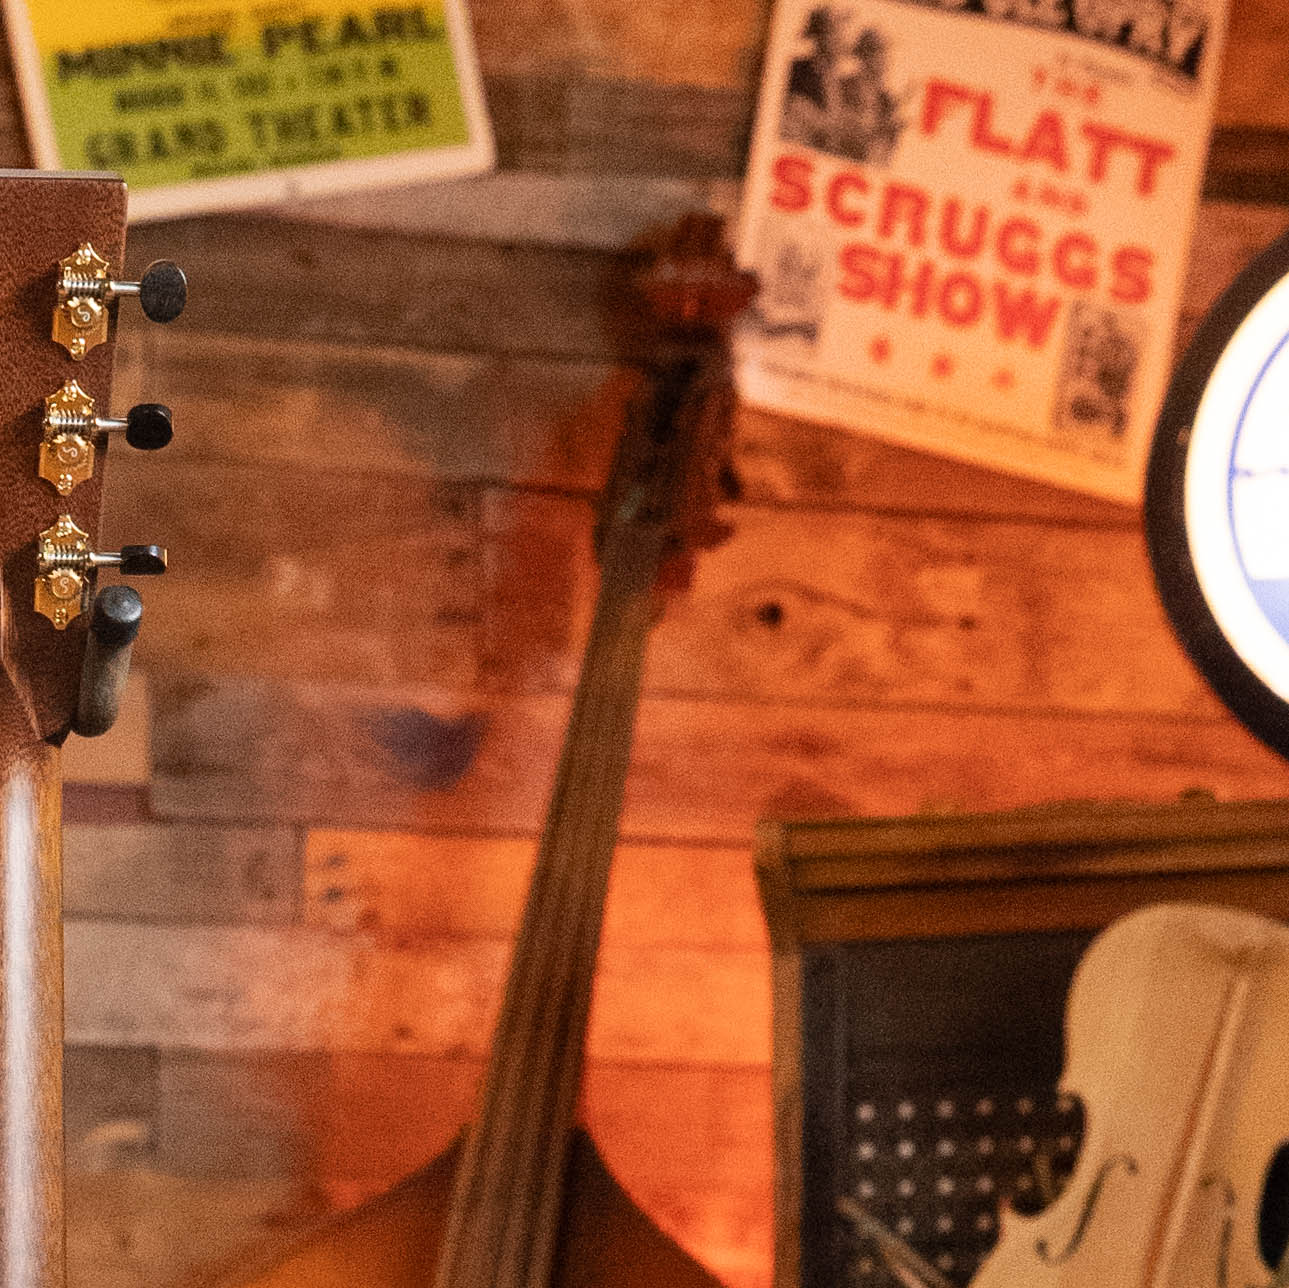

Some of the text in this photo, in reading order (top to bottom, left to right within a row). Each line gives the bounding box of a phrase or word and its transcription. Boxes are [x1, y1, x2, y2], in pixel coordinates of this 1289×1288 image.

[262, 6, 442, 58] PEARL
[84, 117, 228, 170] GRAND
[247, 88, 433, 149] THEATER
[919, 75, 1179, 197] FLATT
[770, 153, 1156, 306] SCRUGGS
[837, 242, 1061, 350] SHOW
